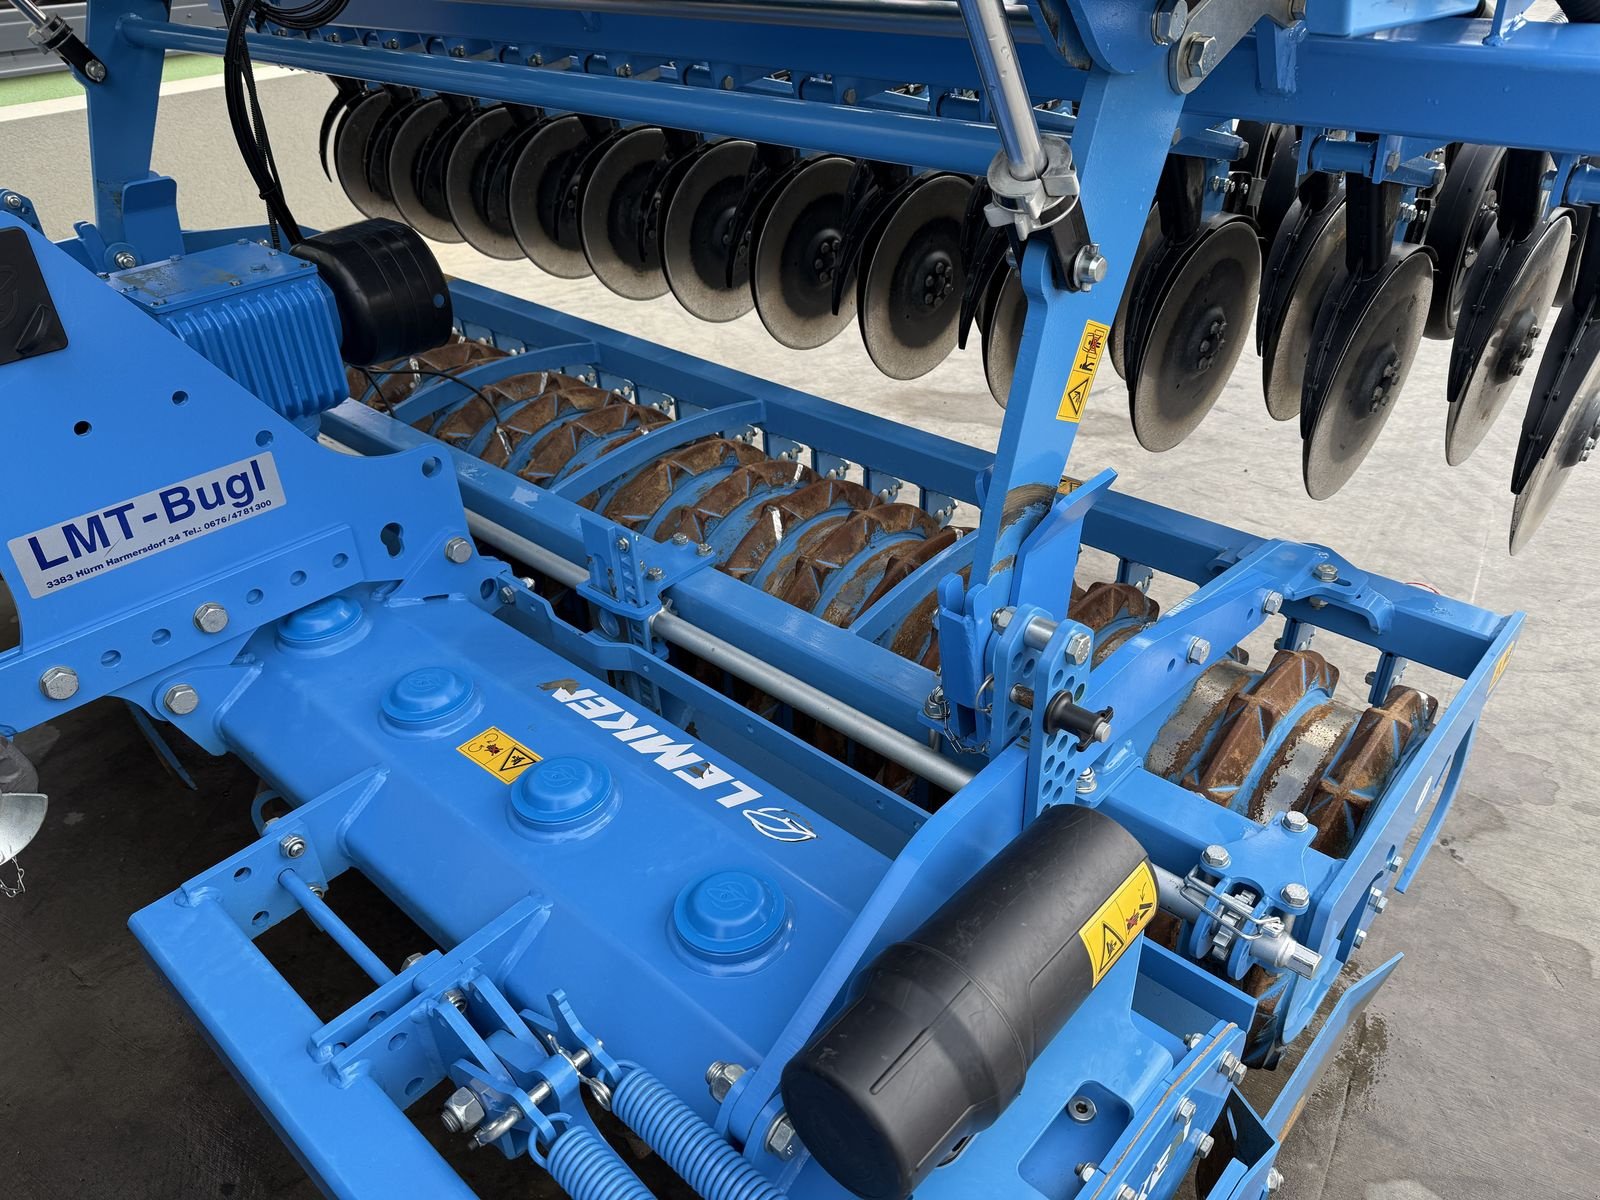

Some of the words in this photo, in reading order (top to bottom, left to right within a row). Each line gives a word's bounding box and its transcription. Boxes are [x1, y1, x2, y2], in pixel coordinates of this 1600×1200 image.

[28, 459, 266, 571] LMT-Bugl
[46, 573, 74, 589] 3383
[75, 562, 104, 578] Hürm
[106, 538, 167, 567] Harmersdorf
[168, 533, 181, 543] 34
[183, 526, 202, 537] Tel.:
[203, 499, 272, 530] 0676/4781300
